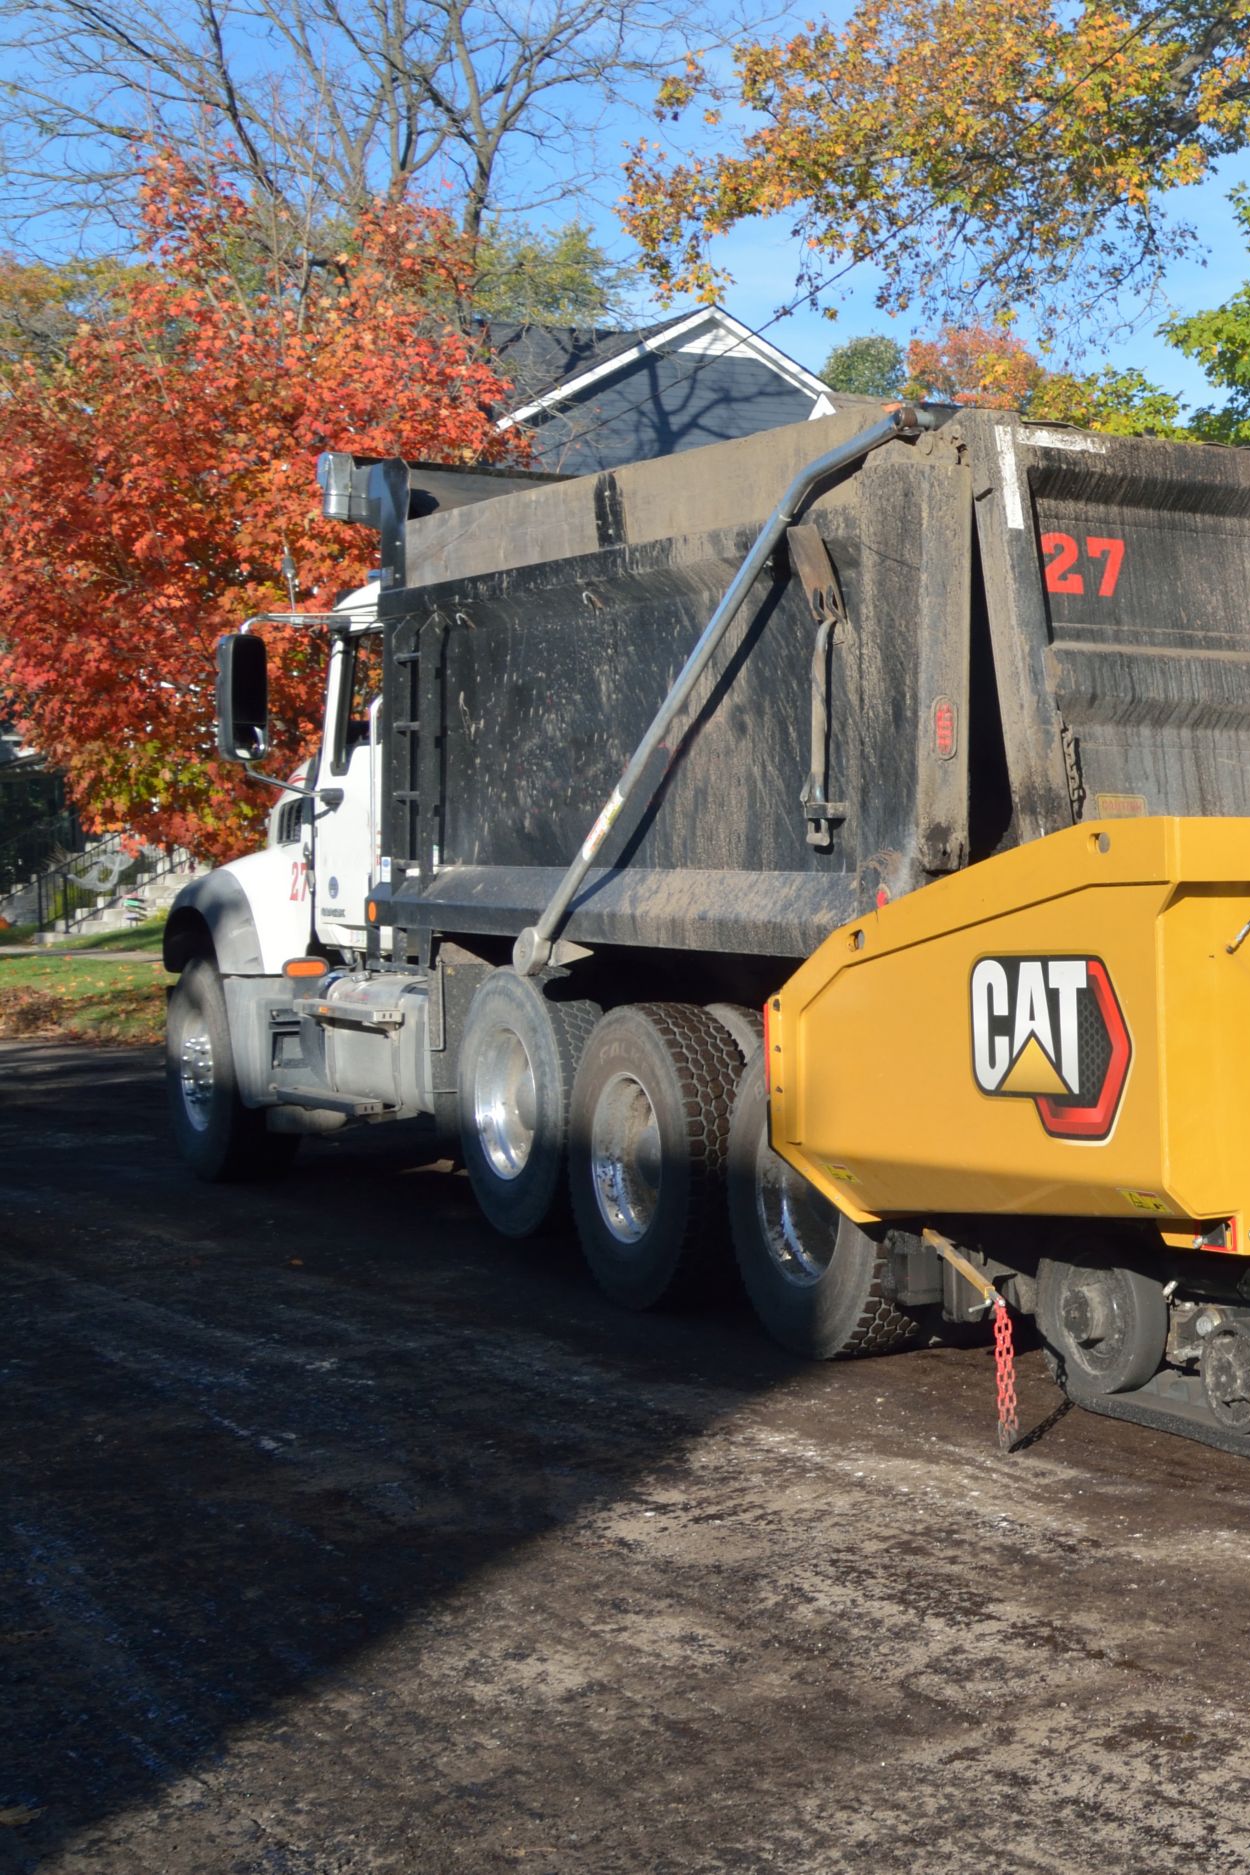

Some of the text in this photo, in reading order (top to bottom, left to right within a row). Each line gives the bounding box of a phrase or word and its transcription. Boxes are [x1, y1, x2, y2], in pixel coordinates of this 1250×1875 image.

[1040, 532, 1126, 597] 27
[290, 861, 309, 902] 27
[972, 958, 1088, 1095] CAT
